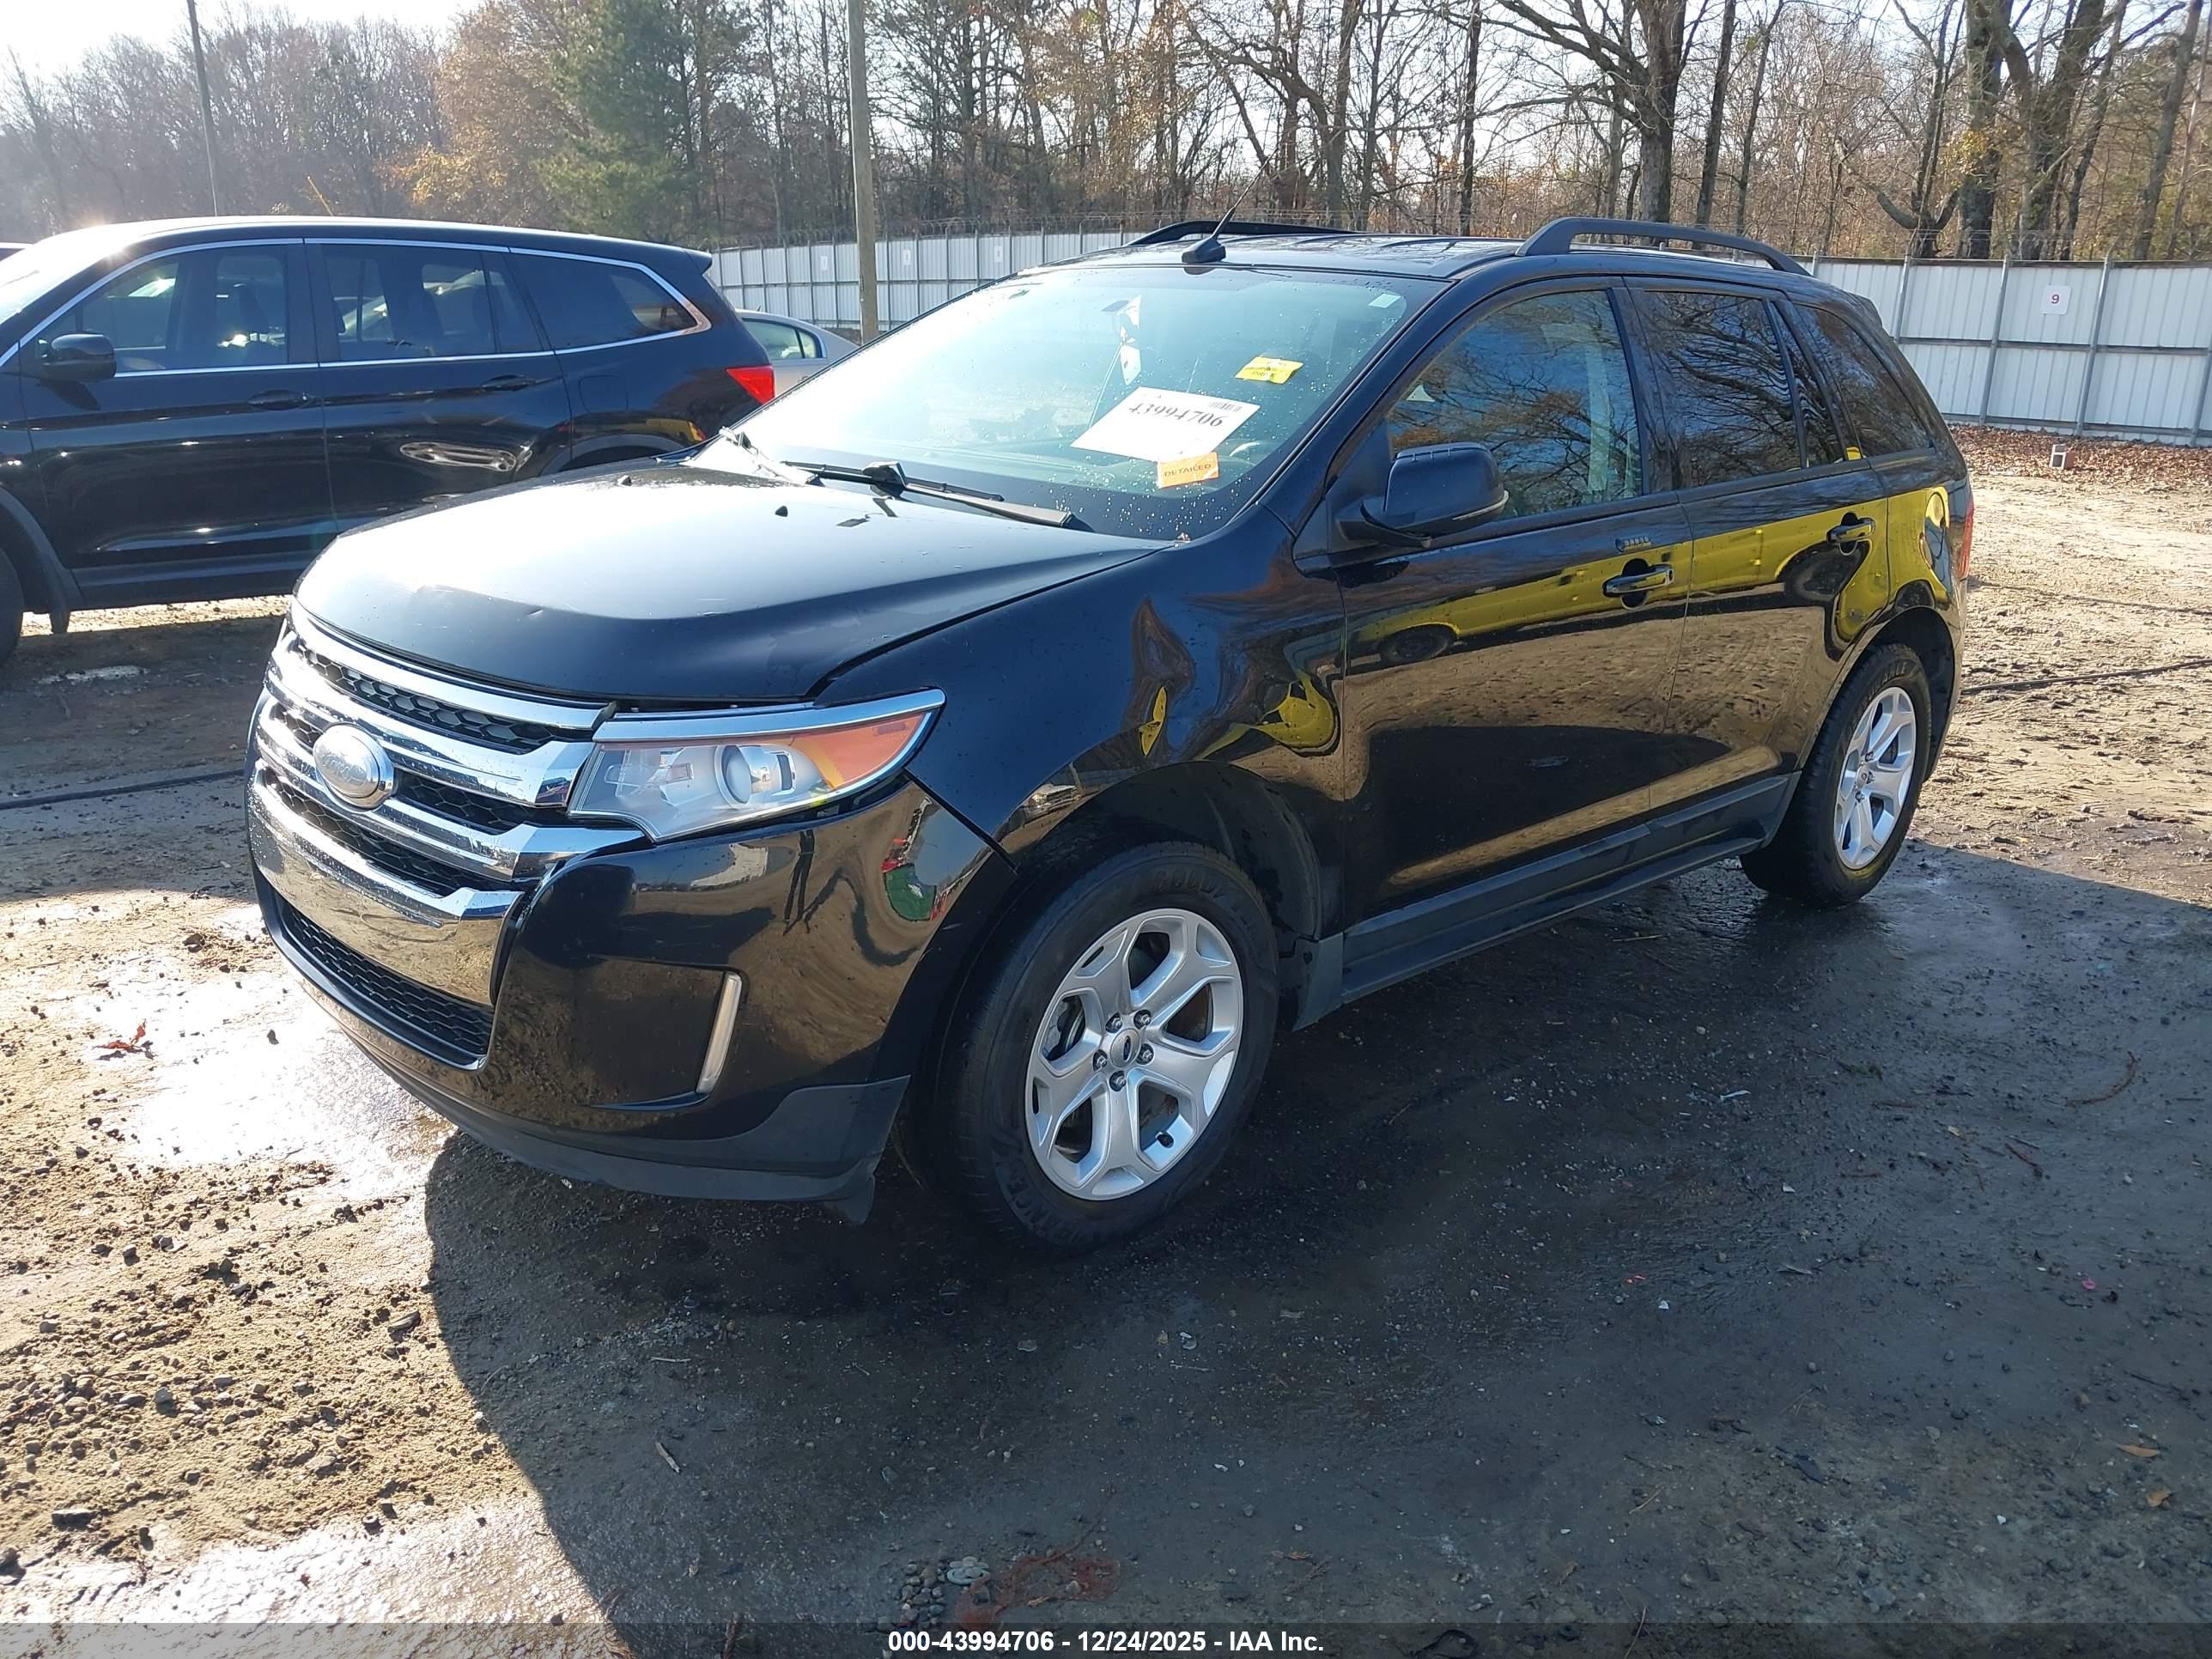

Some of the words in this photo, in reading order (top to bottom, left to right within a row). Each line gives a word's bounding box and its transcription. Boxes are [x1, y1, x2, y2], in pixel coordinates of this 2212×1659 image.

[2051, 294, 2061, 305] 9
[1128, 402, 1225, 427] 43994706
[1164, 463, 1212, 477] DETAILED
